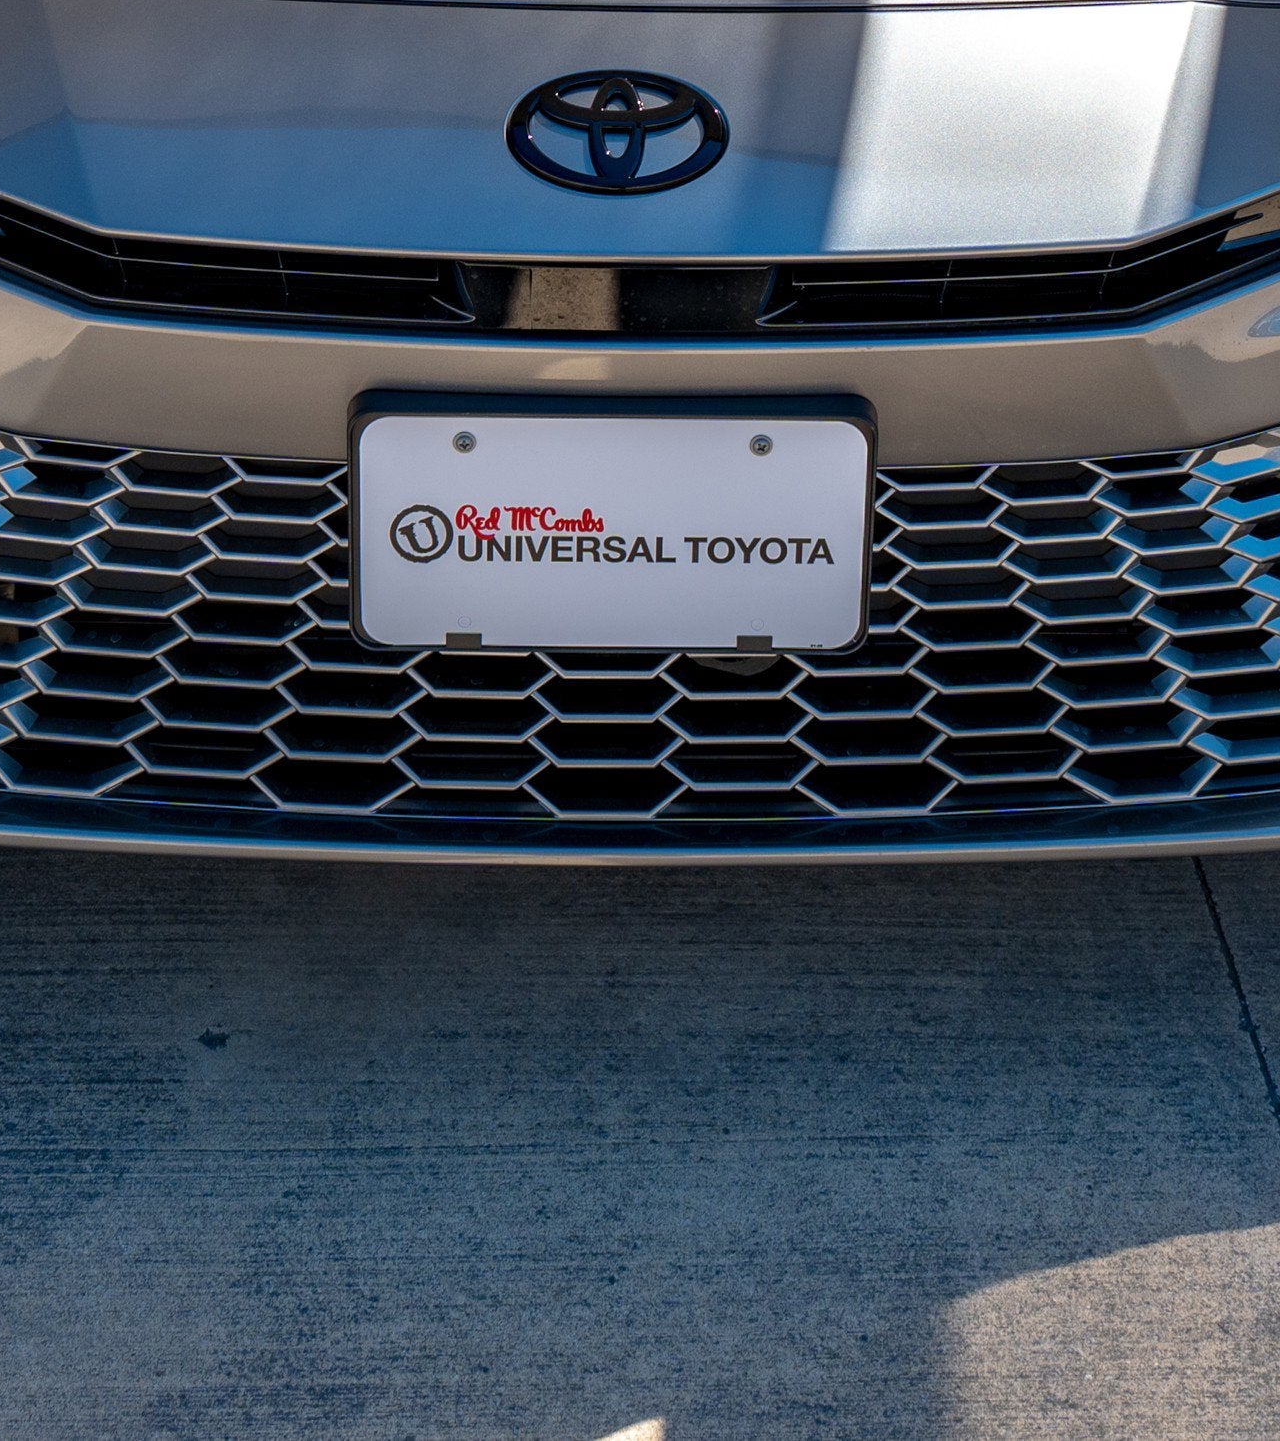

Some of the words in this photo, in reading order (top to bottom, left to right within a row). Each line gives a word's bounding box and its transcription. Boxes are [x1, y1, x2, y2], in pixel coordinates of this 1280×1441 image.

[456, 504, 501, 540] Red
[504, 505, 605, 533] McCombs
[457, 535, 677, 564] UNIVERSAL
[684, 536, 836, 565] TOYOTA
